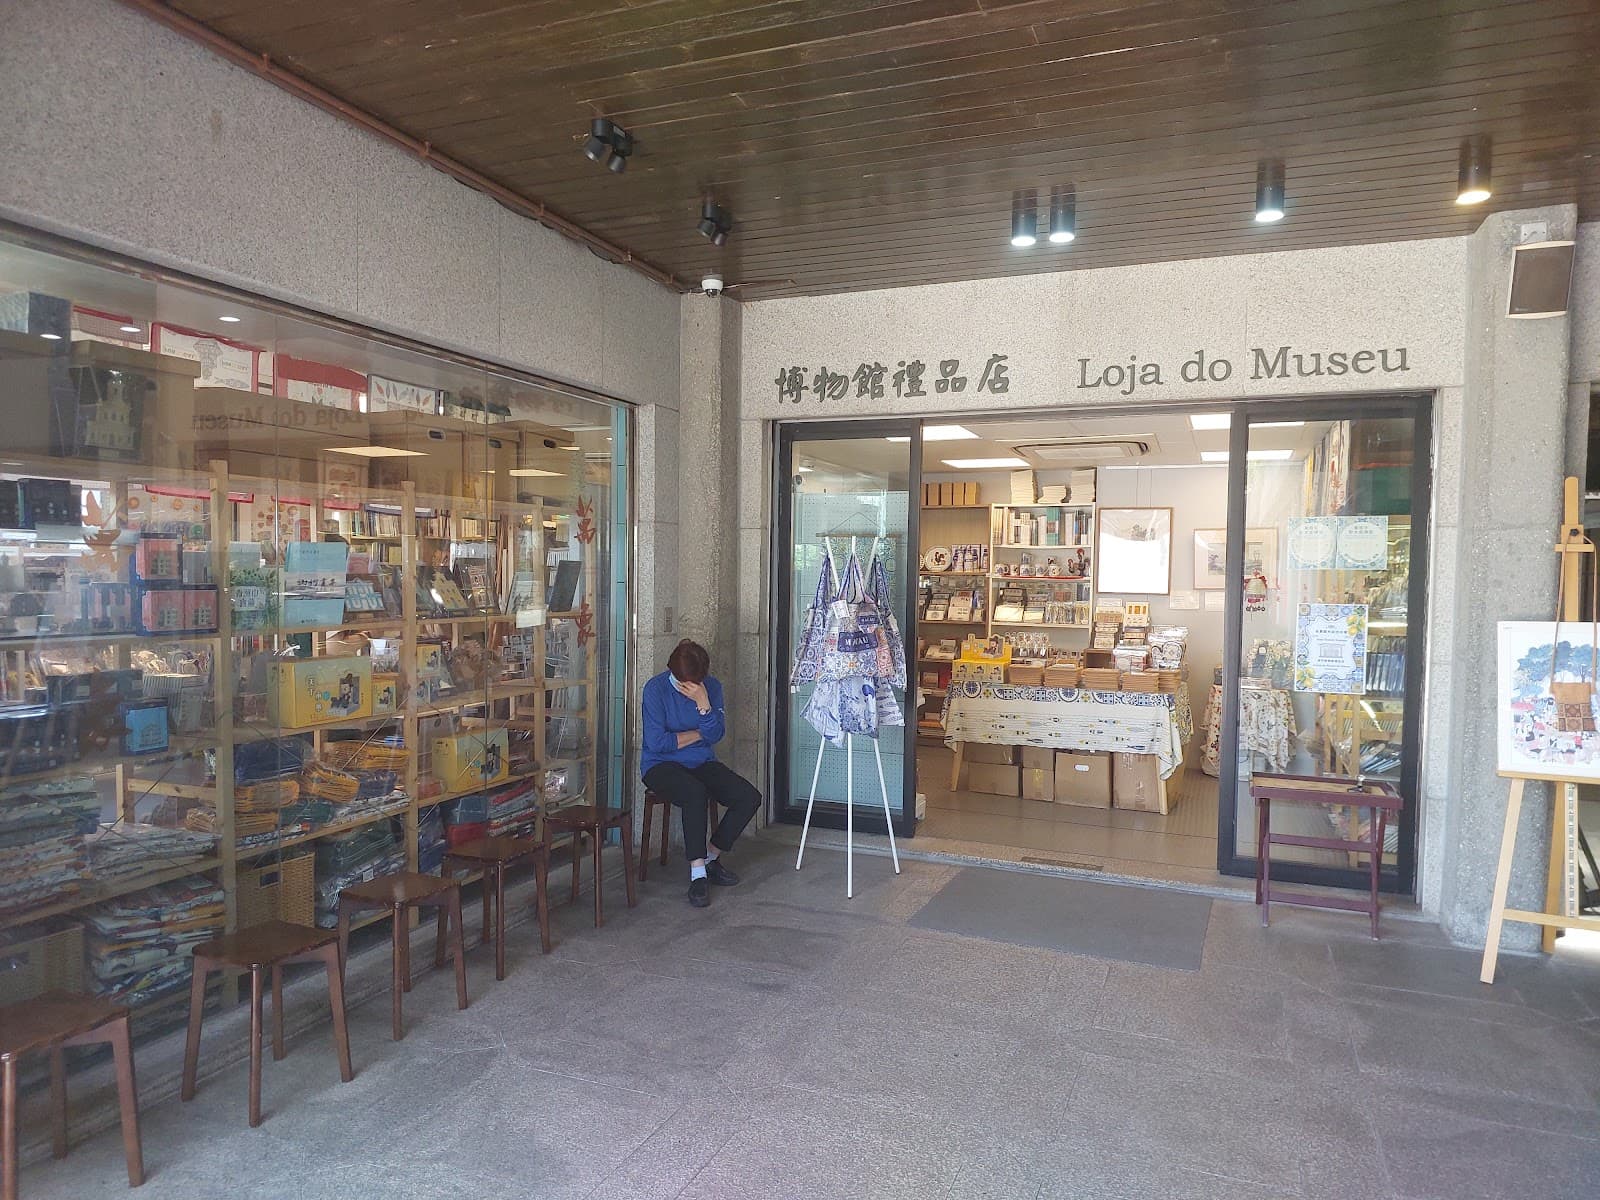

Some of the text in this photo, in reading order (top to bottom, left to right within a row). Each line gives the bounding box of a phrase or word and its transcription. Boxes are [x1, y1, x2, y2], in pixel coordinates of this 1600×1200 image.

[774, 354, 1010, 404] 博物館禮品店
[1077, 347, 1410, 395] Loja do Museu
